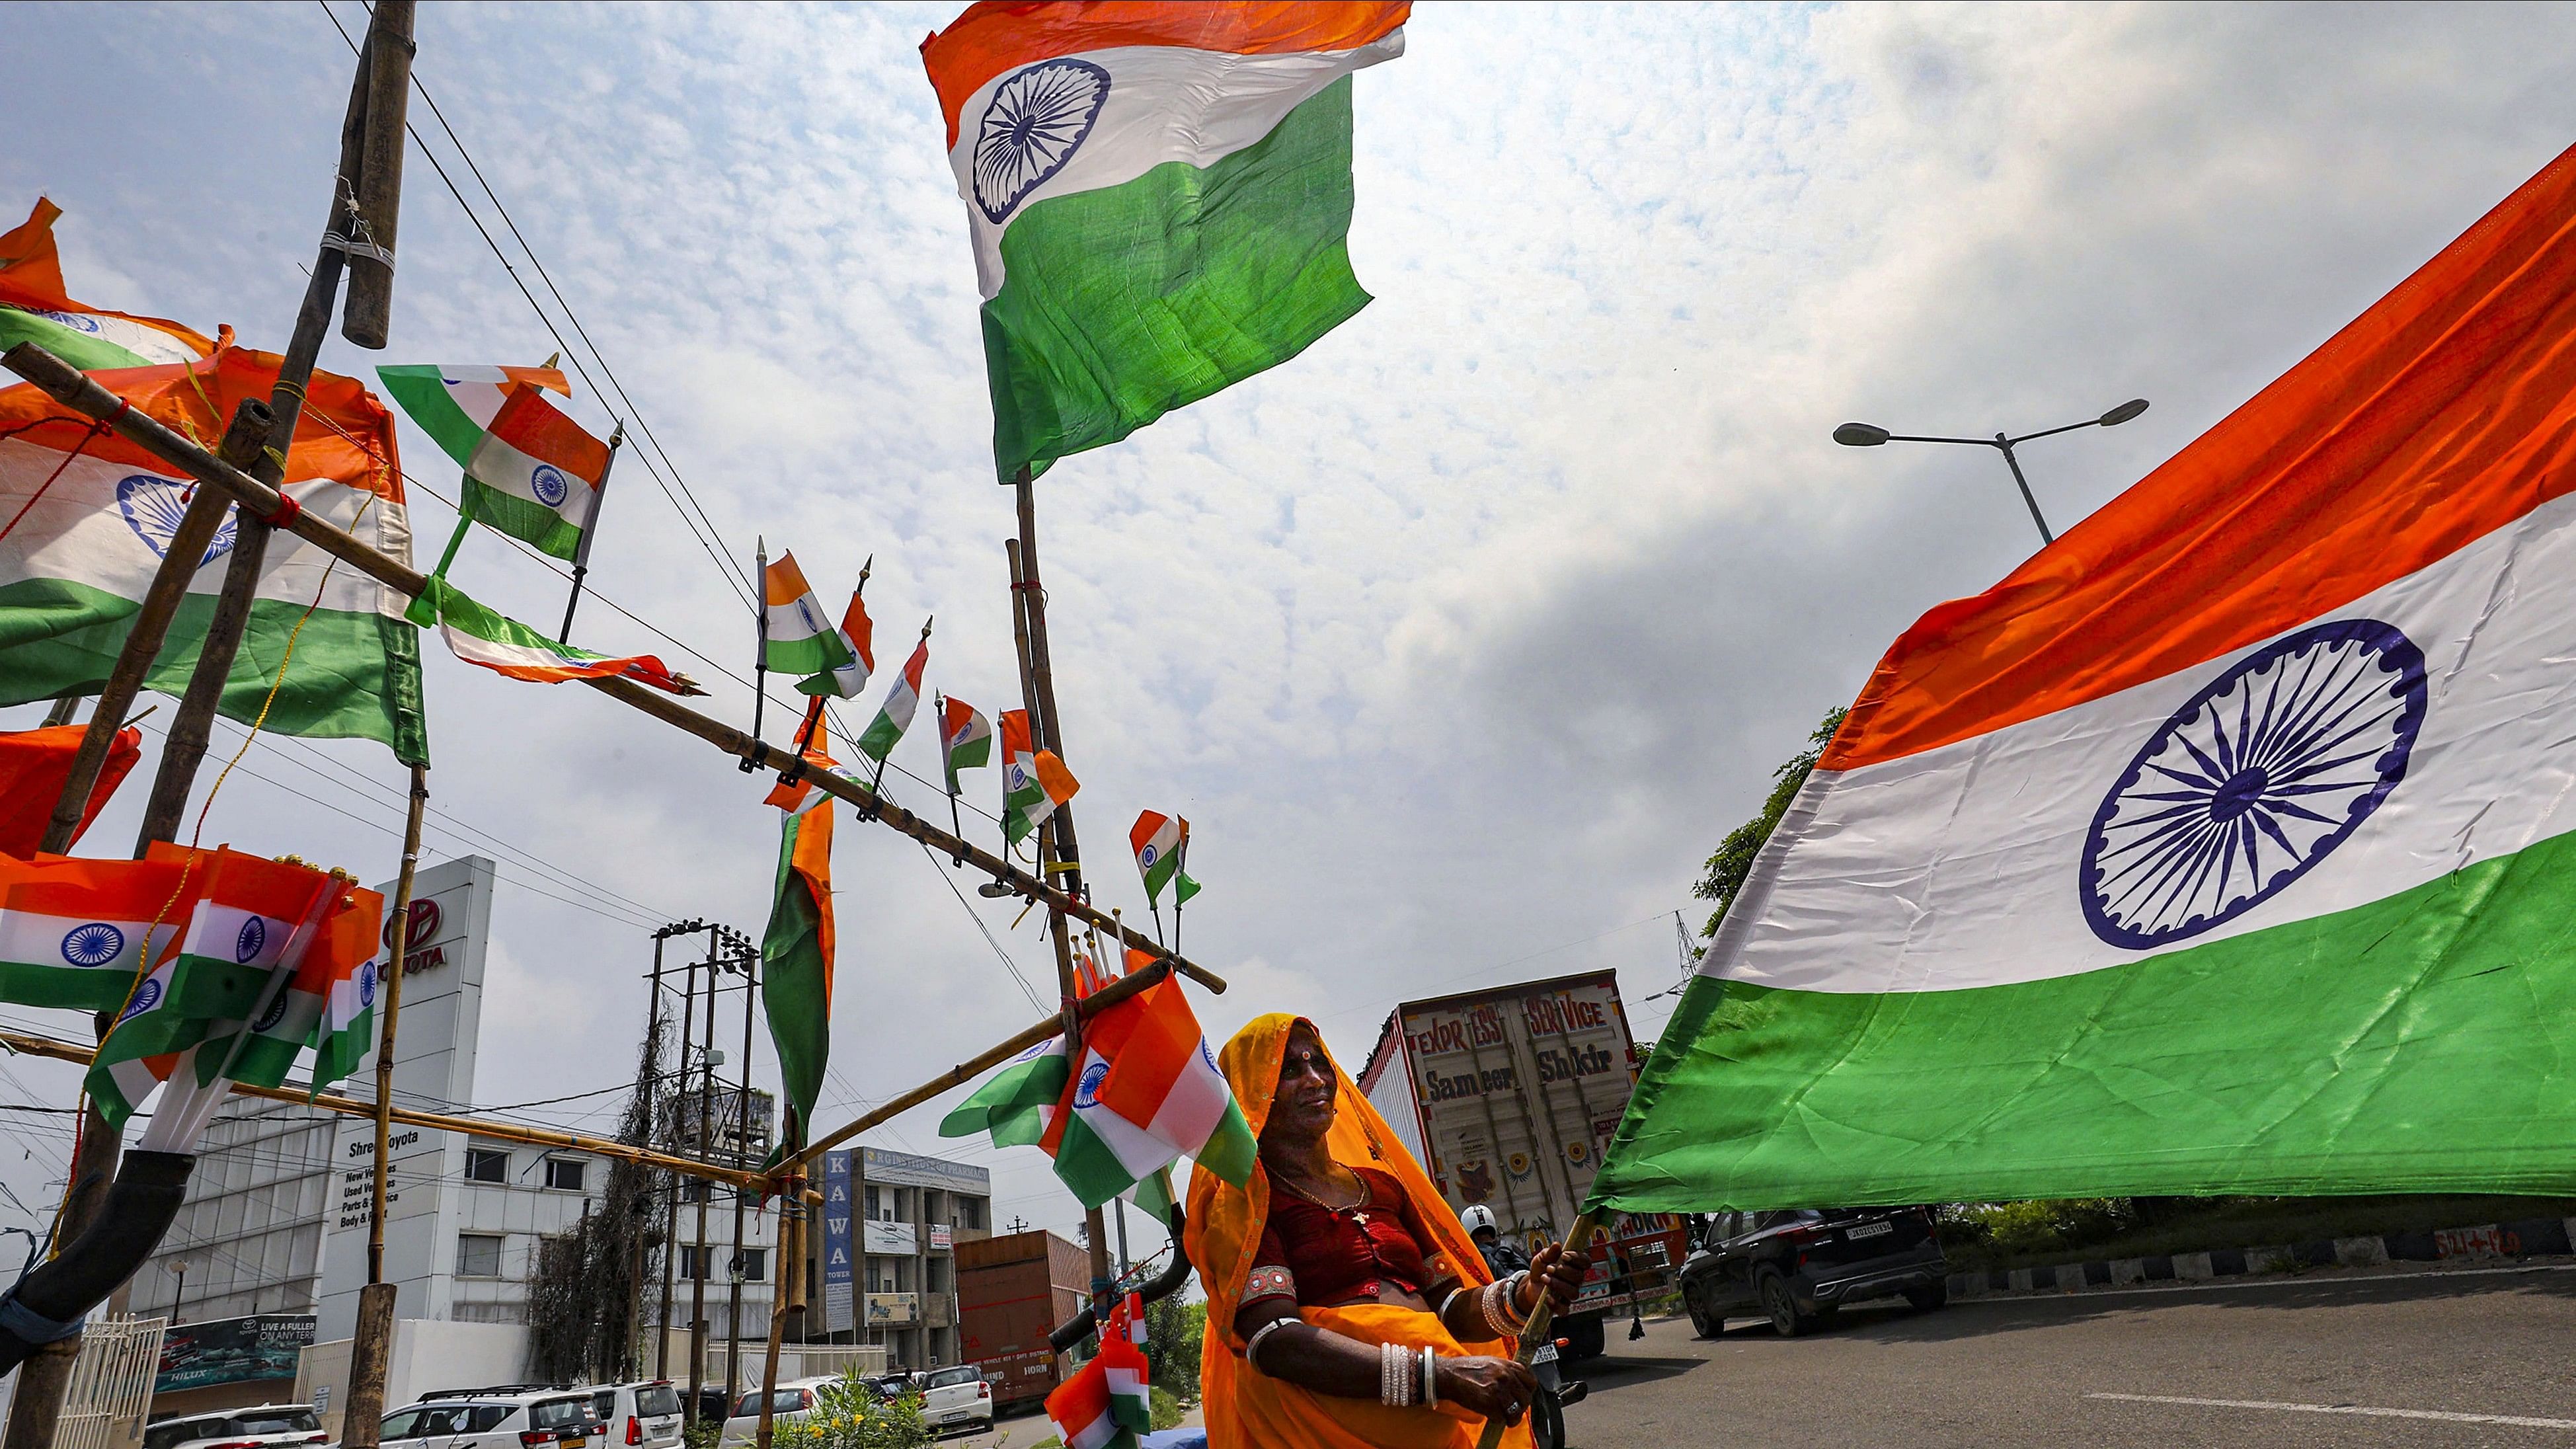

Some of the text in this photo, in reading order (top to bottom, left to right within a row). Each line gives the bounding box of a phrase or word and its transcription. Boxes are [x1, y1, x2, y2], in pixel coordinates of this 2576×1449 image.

[377, 946, 445, 982] OOTA
[349, 1131, 418, 1157] Shre oyota
[877, 1152, 884, 1163] R
[885, 1154, 891, 1165] G
[947, 1164, 988, 1179] PHARMACY
[346, 1173, 364, 1183] New
[344, 1185, 362, 1197] Used
[342, 1200, 361, 1212] Parts
[362, 1198, 369, 1208] &
[340, 1215, 359, 1228] Body
[360, 1213, 366, 1223] &
[261, 1323, 279, 1331] LIVE
[287, 1322, 315, 1331] FULLER
[260, 1331, 275, 1341] ON
[276, 1331, 294, 1340] ANY
[1024, 1364, 1048, 1376] HORN
